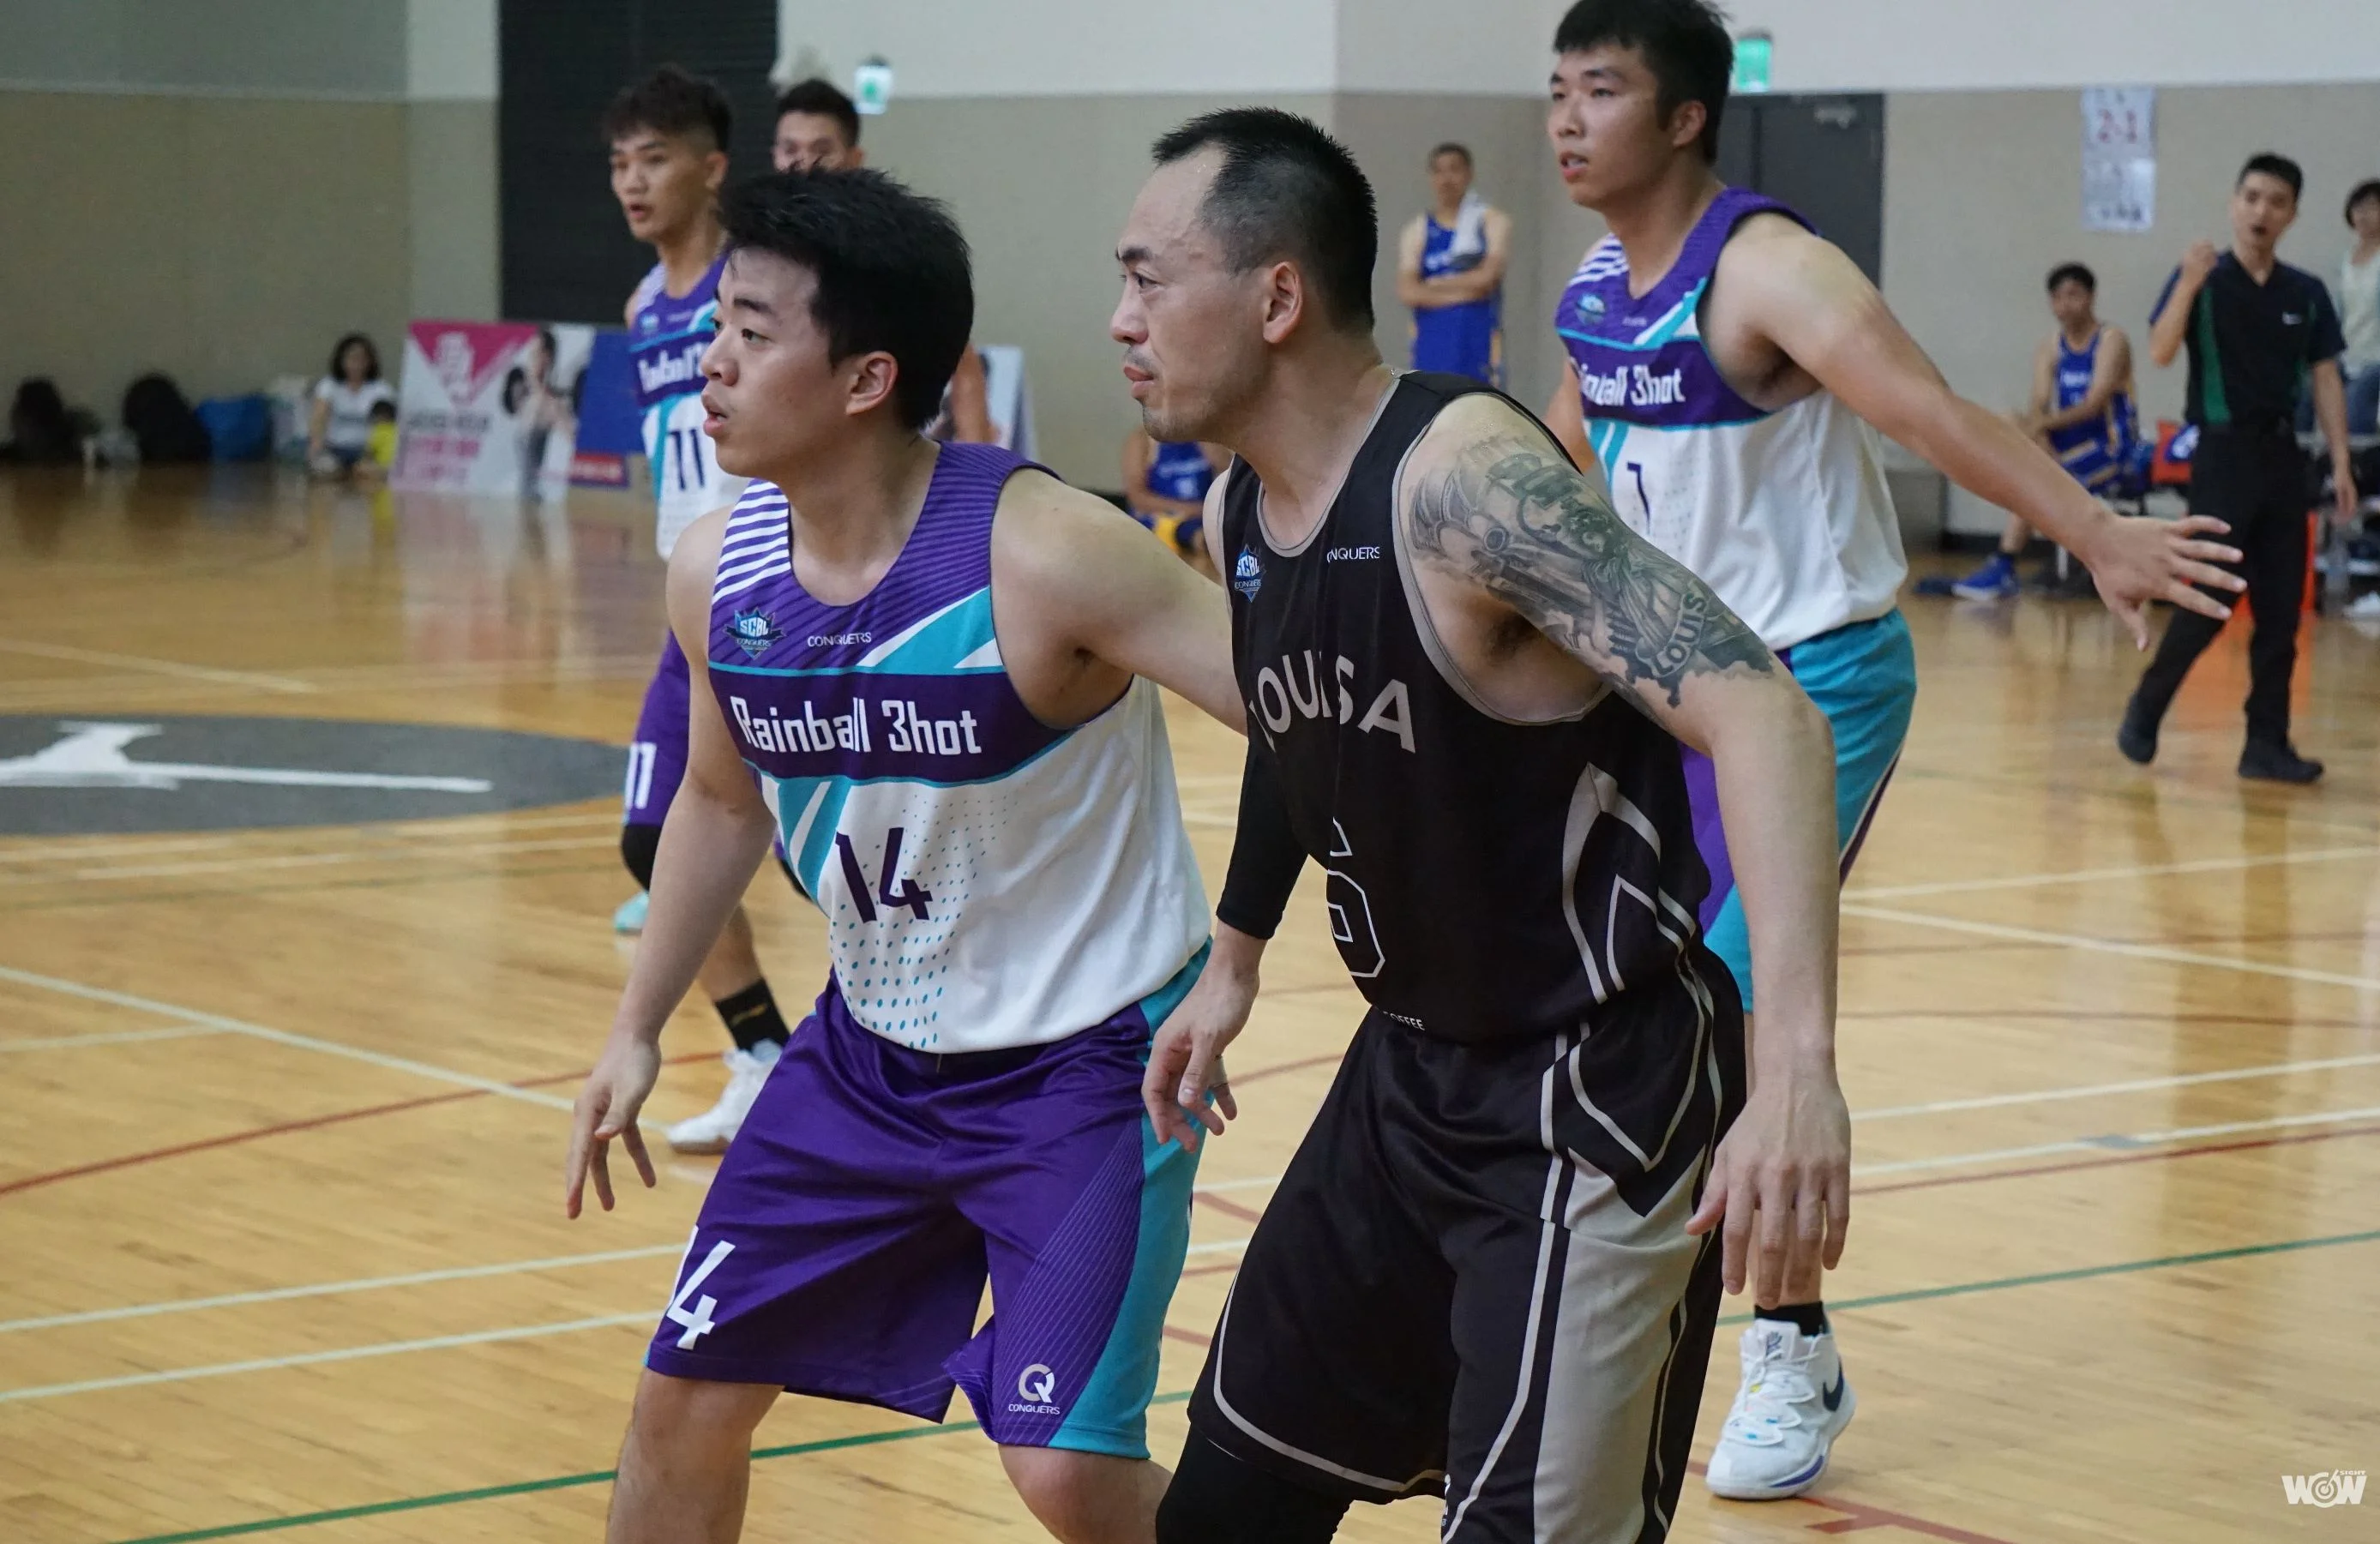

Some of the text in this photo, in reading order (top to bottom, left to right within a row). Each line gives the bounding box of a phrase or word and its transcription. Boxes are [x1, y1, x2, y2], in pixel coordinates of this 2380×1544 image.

[669, 430, 705, 492] 11
[1626, 462, 1650, 534] 7
[1327, 546, 1380, 563] NQUERS
[740, 617, 768, 637] SCBL
[807, 632, 872, 647] CONQUERS
[1654, 592, 1707, 676] LOUIS
[730, 695, 983, 755] Rainball 3hot
[835, 826, 933, 923] 14
[1008, 1403, 1061, 1415] CONQUERS
